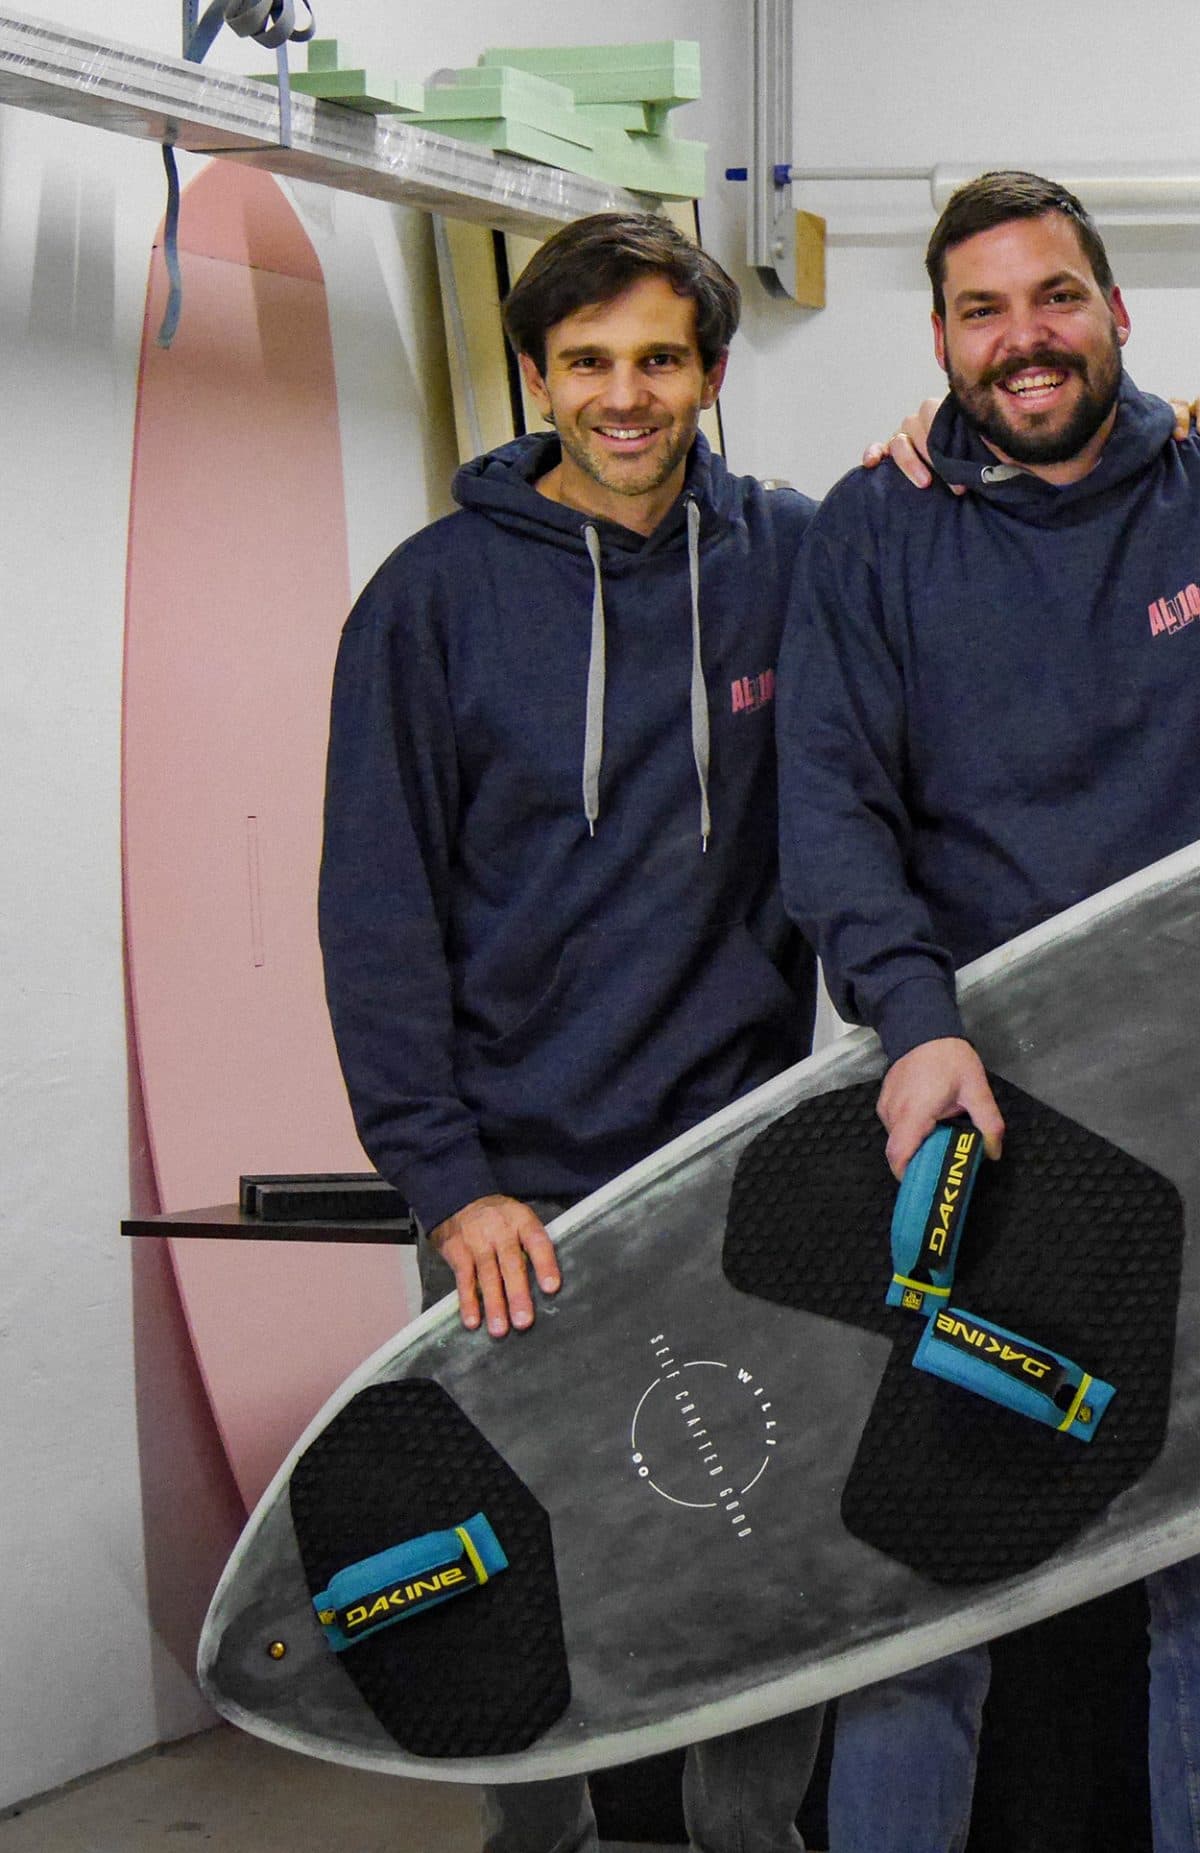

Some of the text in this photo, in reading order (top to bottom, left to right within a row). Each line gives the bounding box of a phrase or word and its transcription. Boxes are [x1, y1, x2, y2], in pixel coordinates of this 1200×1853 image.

[929, 1132, 975, 1257] DAKINE
[936, 1312, 1051, 1379] DAKINE
[650, 1334, 752, 1537] SELF CRAFTED GOOD
[737, 1367, 777, 1446] WILLI
[346, 1567, 467, 1628] DAKINE
